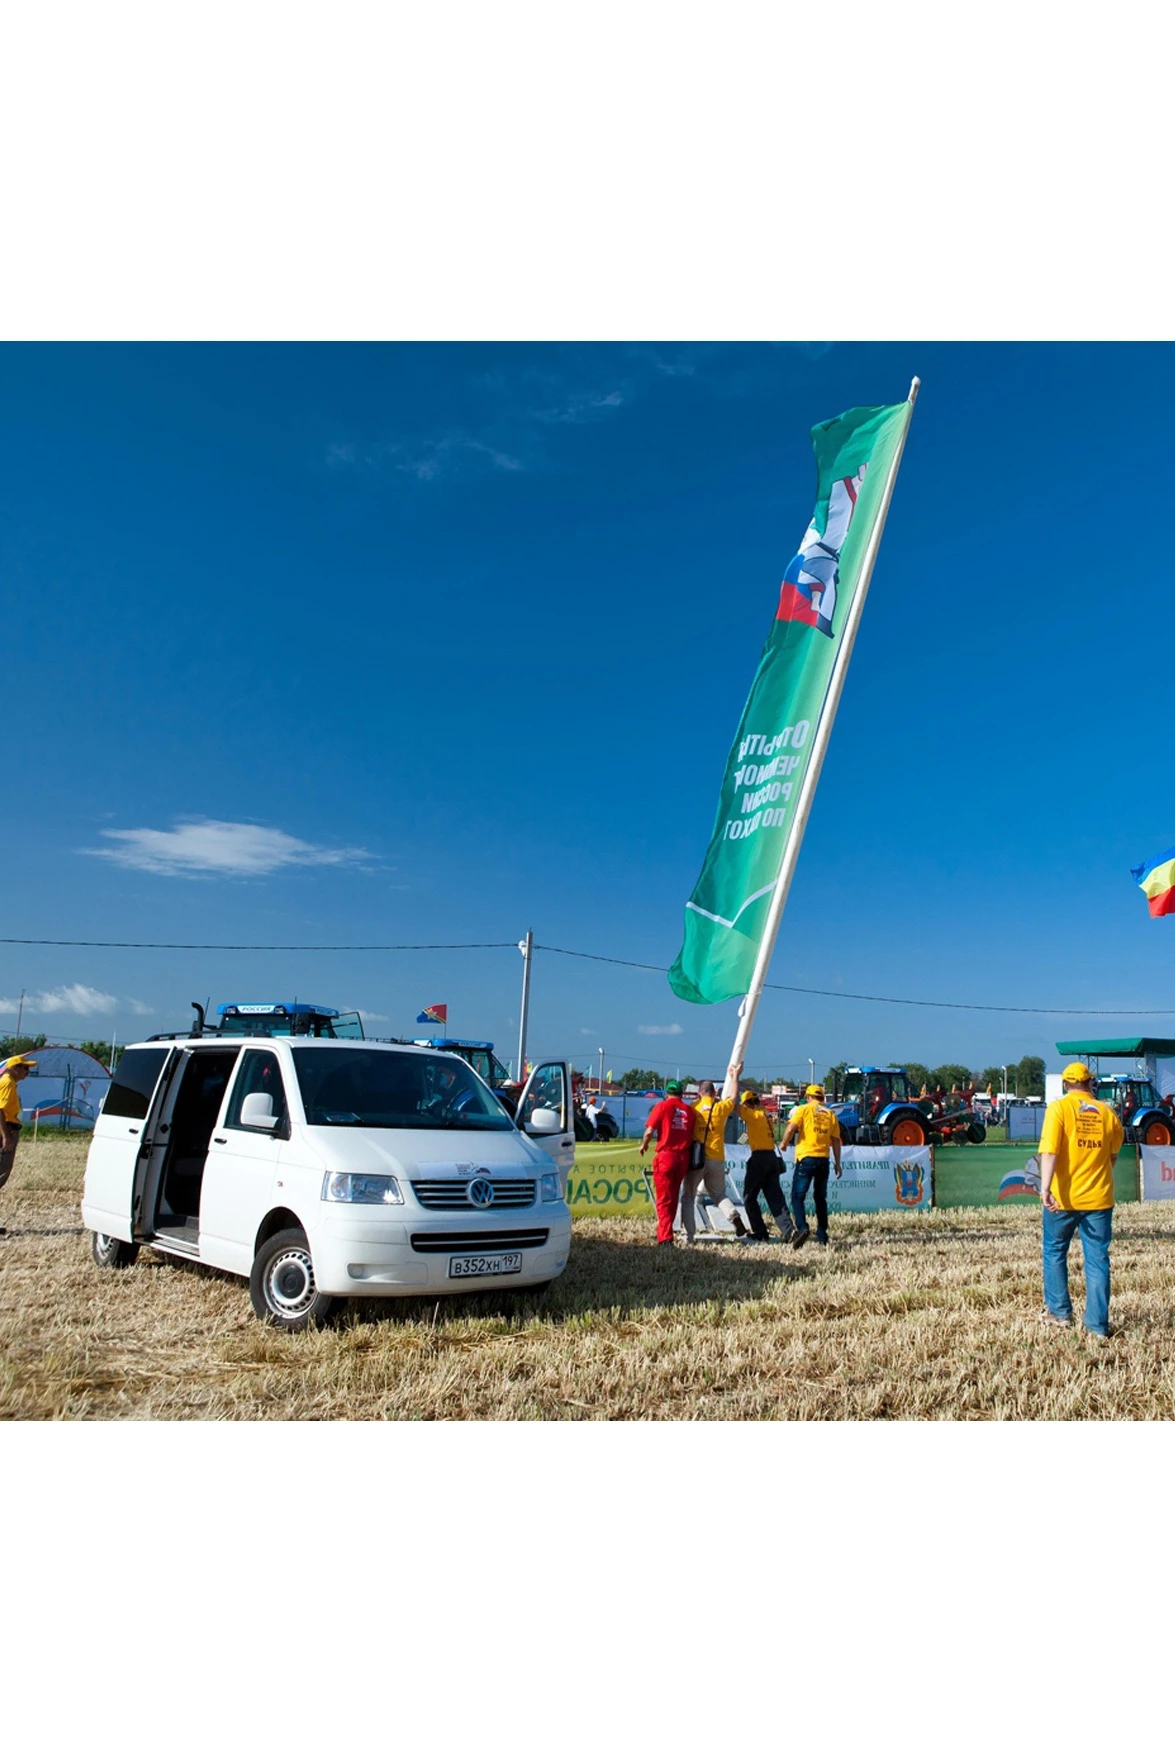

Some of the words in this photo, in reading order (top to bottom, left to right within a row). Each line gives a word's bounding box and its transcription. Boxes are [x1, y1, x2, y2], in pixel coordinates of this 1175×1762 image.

[1077, 1138, 1102, 1149] СУДЬЯ
[455, 1258, 500, 1274] В352ХН
[502, 1254, 519, 1266] 197
